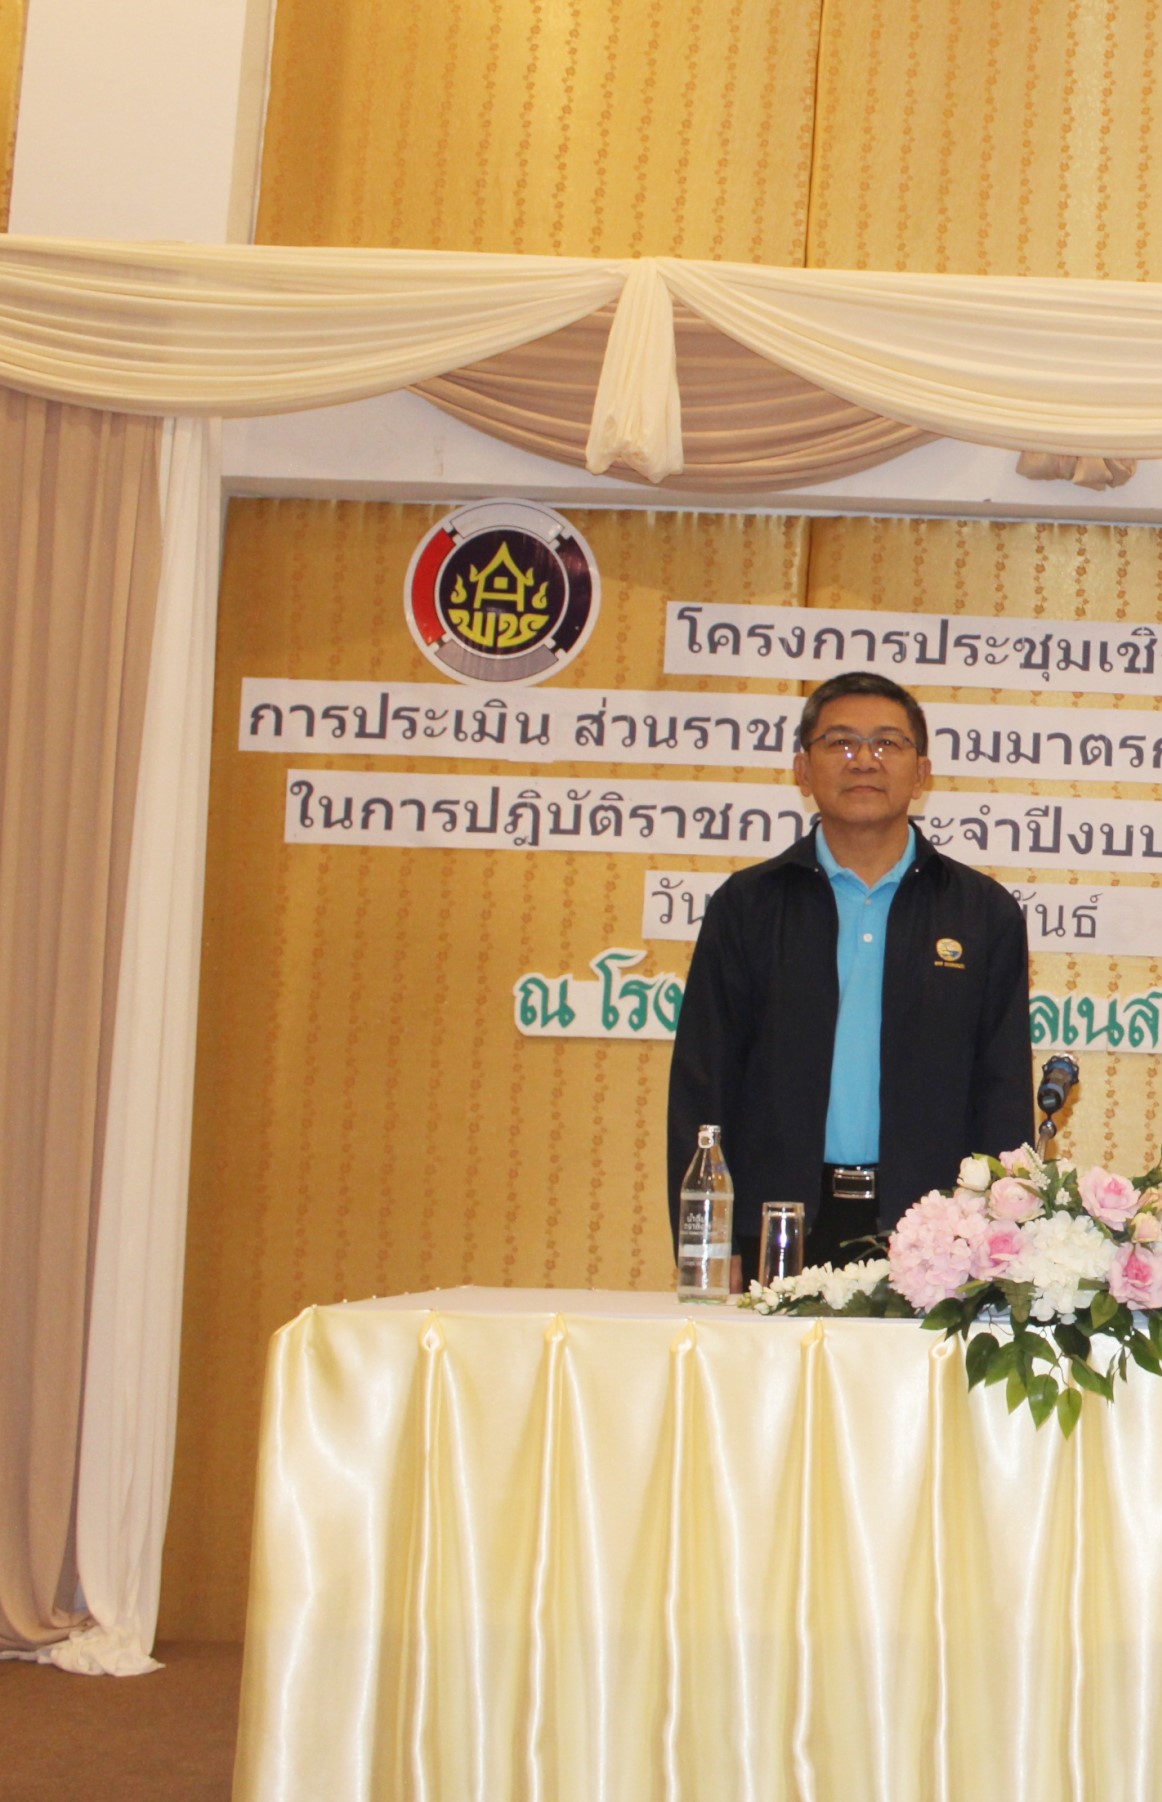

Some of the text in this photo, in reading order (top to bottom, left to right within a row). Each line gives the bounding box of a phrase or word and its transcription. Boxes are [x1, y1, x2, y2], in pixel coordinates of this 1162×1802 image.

[249, 692, 550, 746] การประเมิน
[518, 976, 576, 1029] ณ
